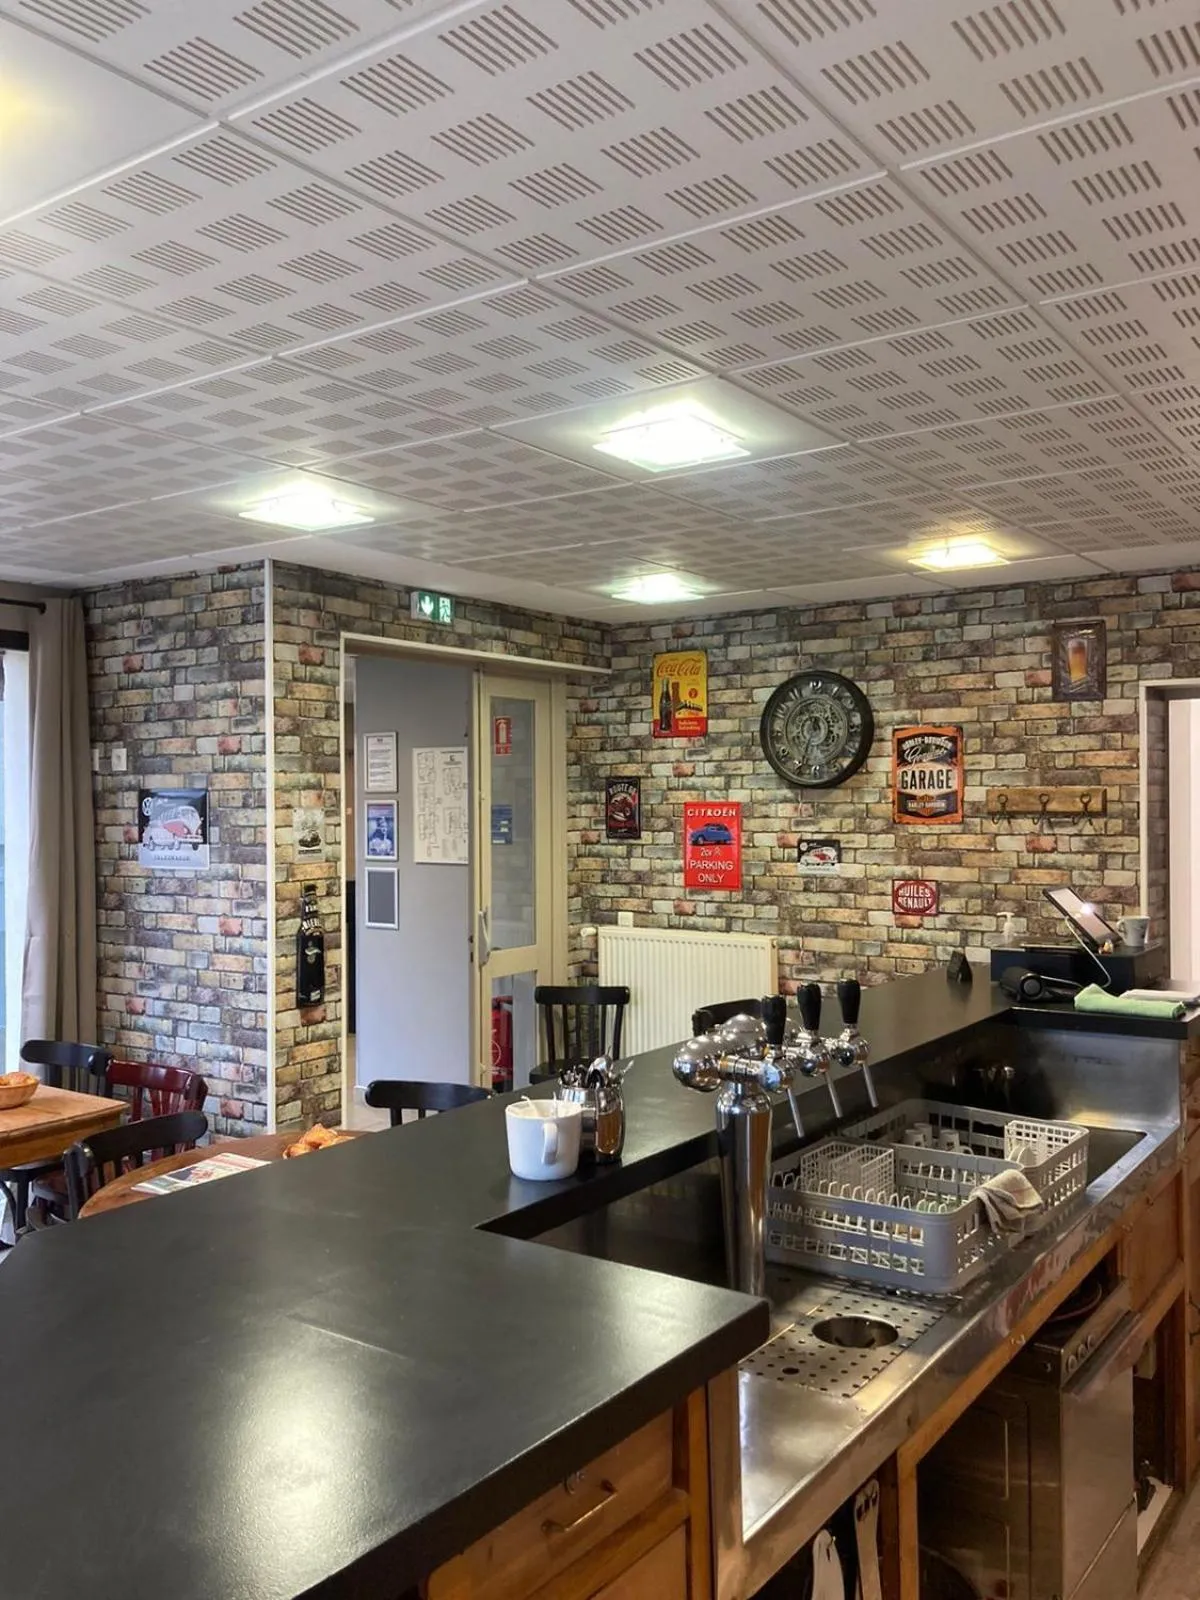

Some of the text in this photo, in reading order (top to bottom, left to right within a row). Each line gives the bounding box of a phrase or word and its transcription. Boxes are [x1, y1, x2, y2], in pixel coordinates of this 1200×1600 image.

[901, 769, 952, 790] GARAGE
[690, 860, 734, 870] PARKING
[698, 873, 725, 883] ONLY
[898, 885, 931, 897] HUILES
[898, 897, 932, 909] RENAULT
